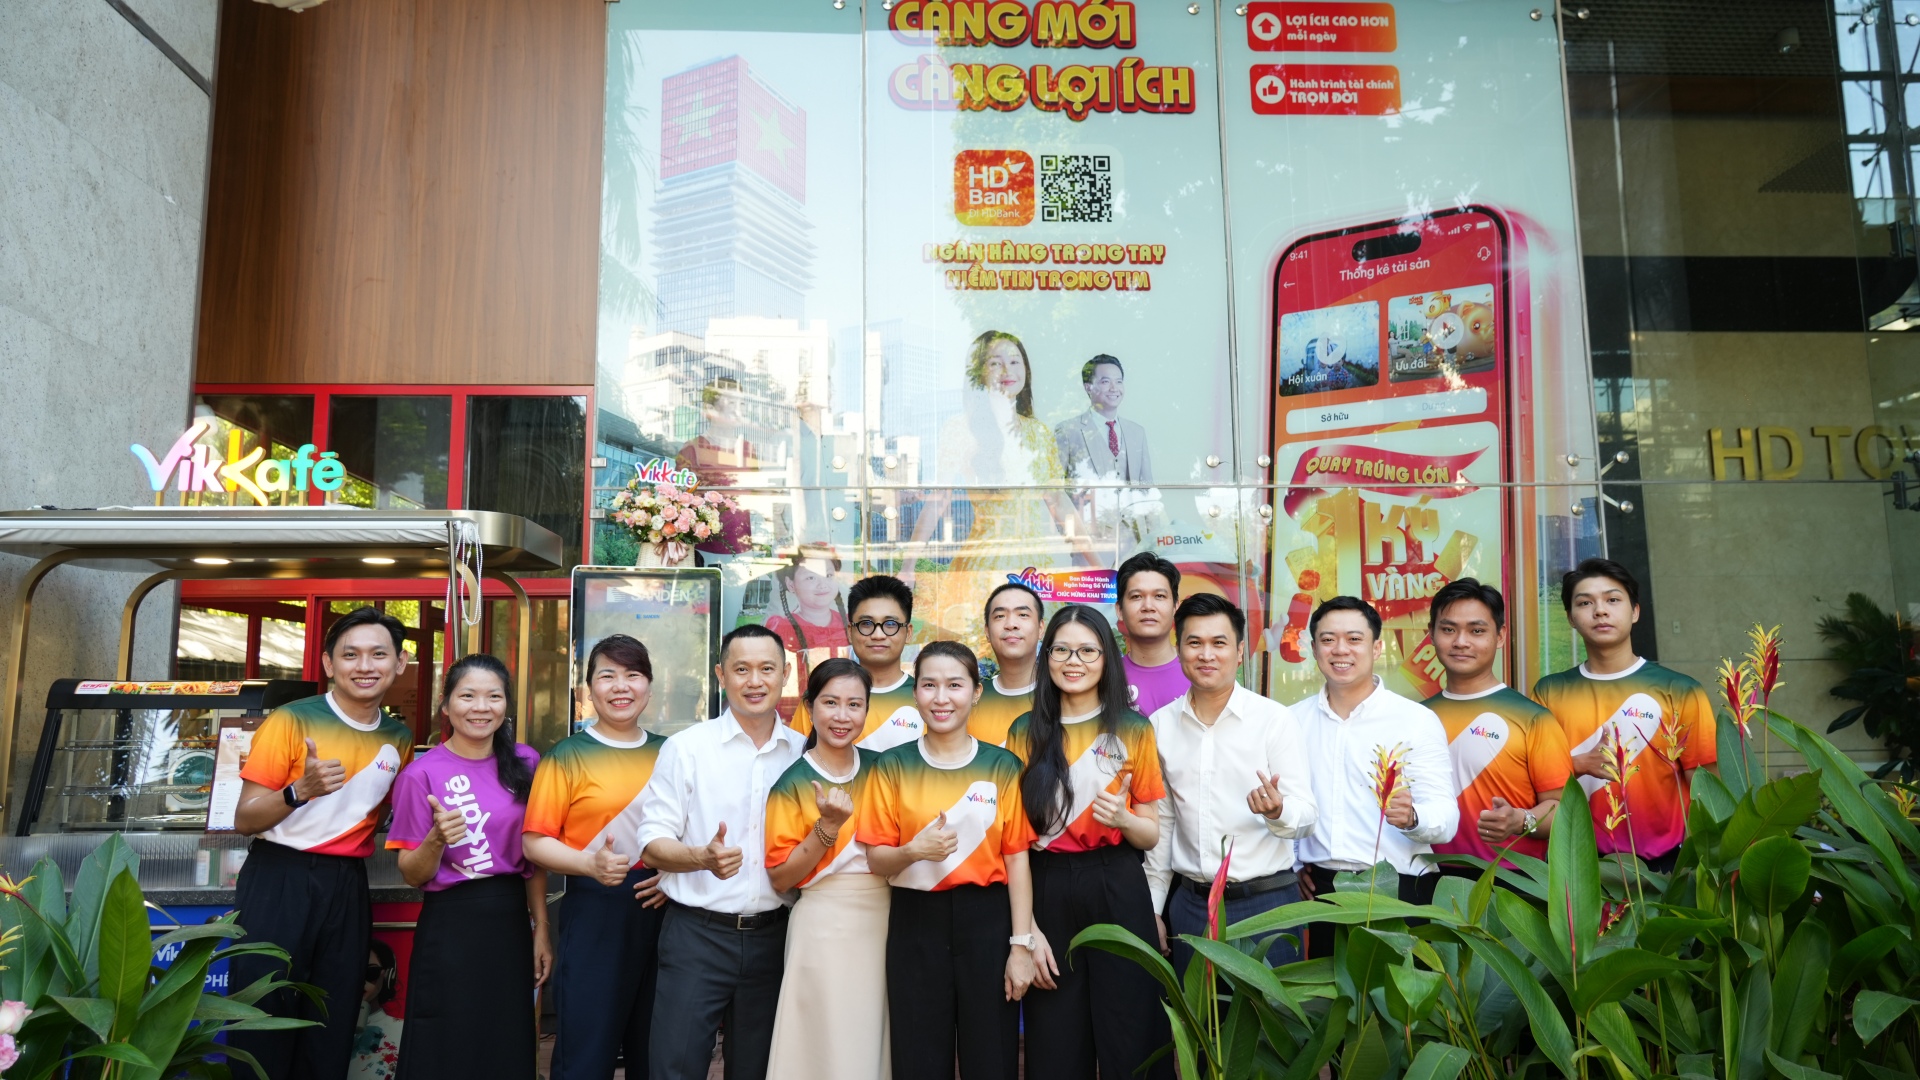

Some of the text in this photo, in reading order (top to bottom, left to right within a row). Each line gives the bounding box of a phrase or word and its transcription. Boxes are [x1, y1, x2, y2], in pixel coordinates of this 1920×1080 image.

[1286, 13, 1389, 28] LỢI ÍCH CAO HƠN
[1287, 29, 1337, 43] mỗi ngày
[892, 54, 1192, 112] CÀNG LỢI ÍCH
[1290, 79, 1394, 89] Hành trình tài chính
[1290, 89, 1358, 107] TRỌN ĐỜI
[969, 166, 1009, 188] HD
[969, 189, 1020, 205] Bank
[982, 209, 1020, 218] HDBank
[924, 240, 1166, 263] NGÂN HÀNG TRONG TAY
[1289, 250, 1308, 261] 9:41
[946, 263, 1150, 289] NIỀM TIN TRONG TIM
[1339, 258, 1430, 282] Thống kê tài sản
[1411, 359, 1427, 369] đãi
[1288, 373, 1327, 387] Hội xuân
[1320, 411, 1349, 422] Sở hữu
[1707, 424, 1920, 481] HD TO
[1305, 456, 1449, 484] QUAY TRÚNG LỚN
[1364, 495, 1440, 566] KÝ
[1157, 535, 1203, 547] HDBank
[1006, 567, 1054, 592] Vikki
[1365, 567, 1446, 601] VÀNG
[631, 589, 691, 602] SANDEN
